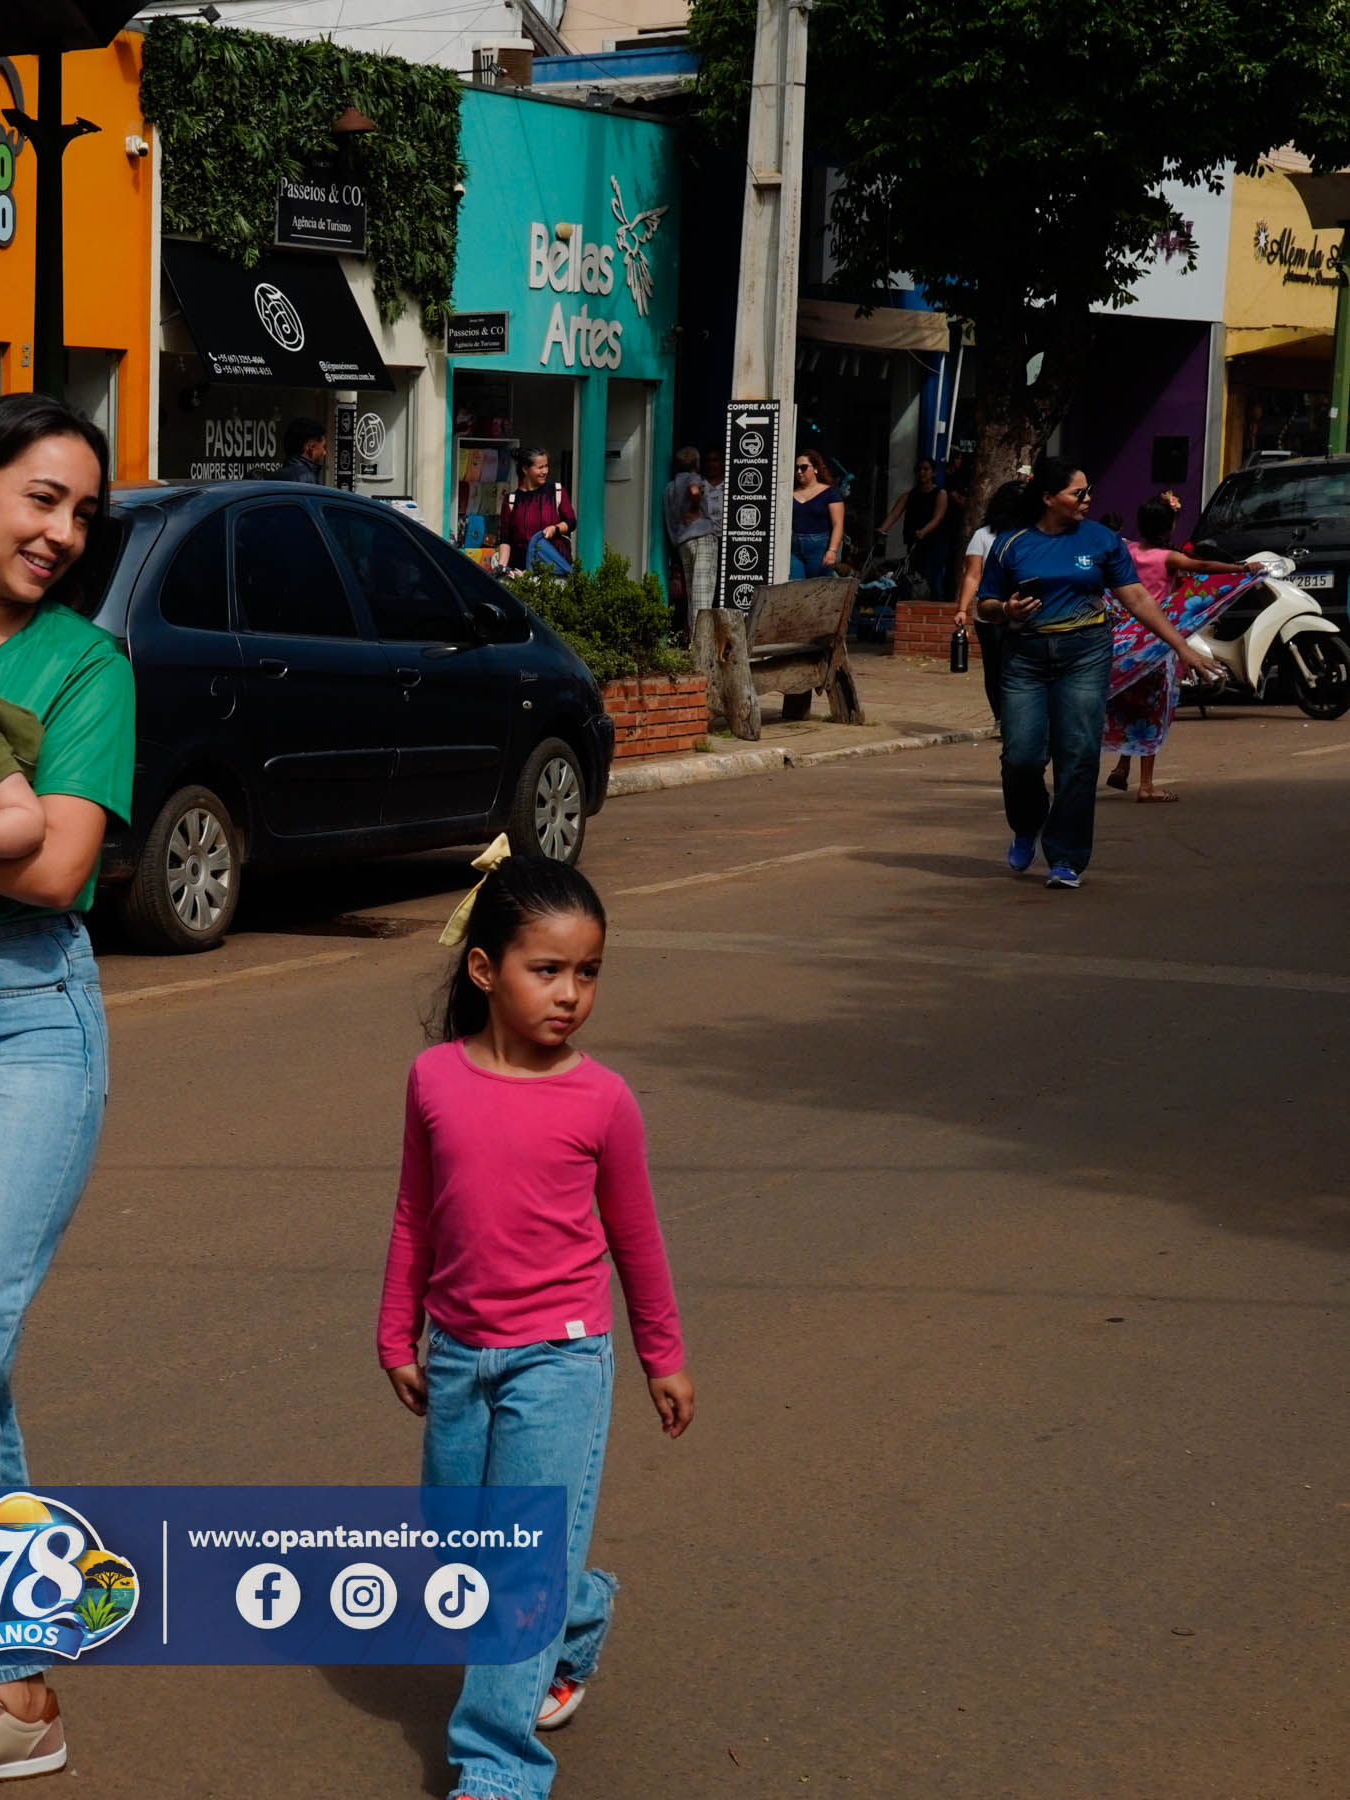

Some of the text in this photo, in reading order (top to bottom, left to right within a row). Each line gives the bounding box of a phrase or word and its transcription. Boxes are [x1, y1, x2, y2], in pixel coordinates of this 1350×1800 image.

[280, 176, 364, 207] Passeios & CO.
[291, 215, 351, 232] Agência de Turismo
[528, 222, 615, 296] Bellas
[449, 327, 480, 337] Passeios
[481, 326, 489, 336] &
[539, 301, 623, 370] Artes
[205, 419, 277, 458] PASSEIOS
[190, 462, 226, 480] COMPRE
[227, 462, 244, 480] SEU
